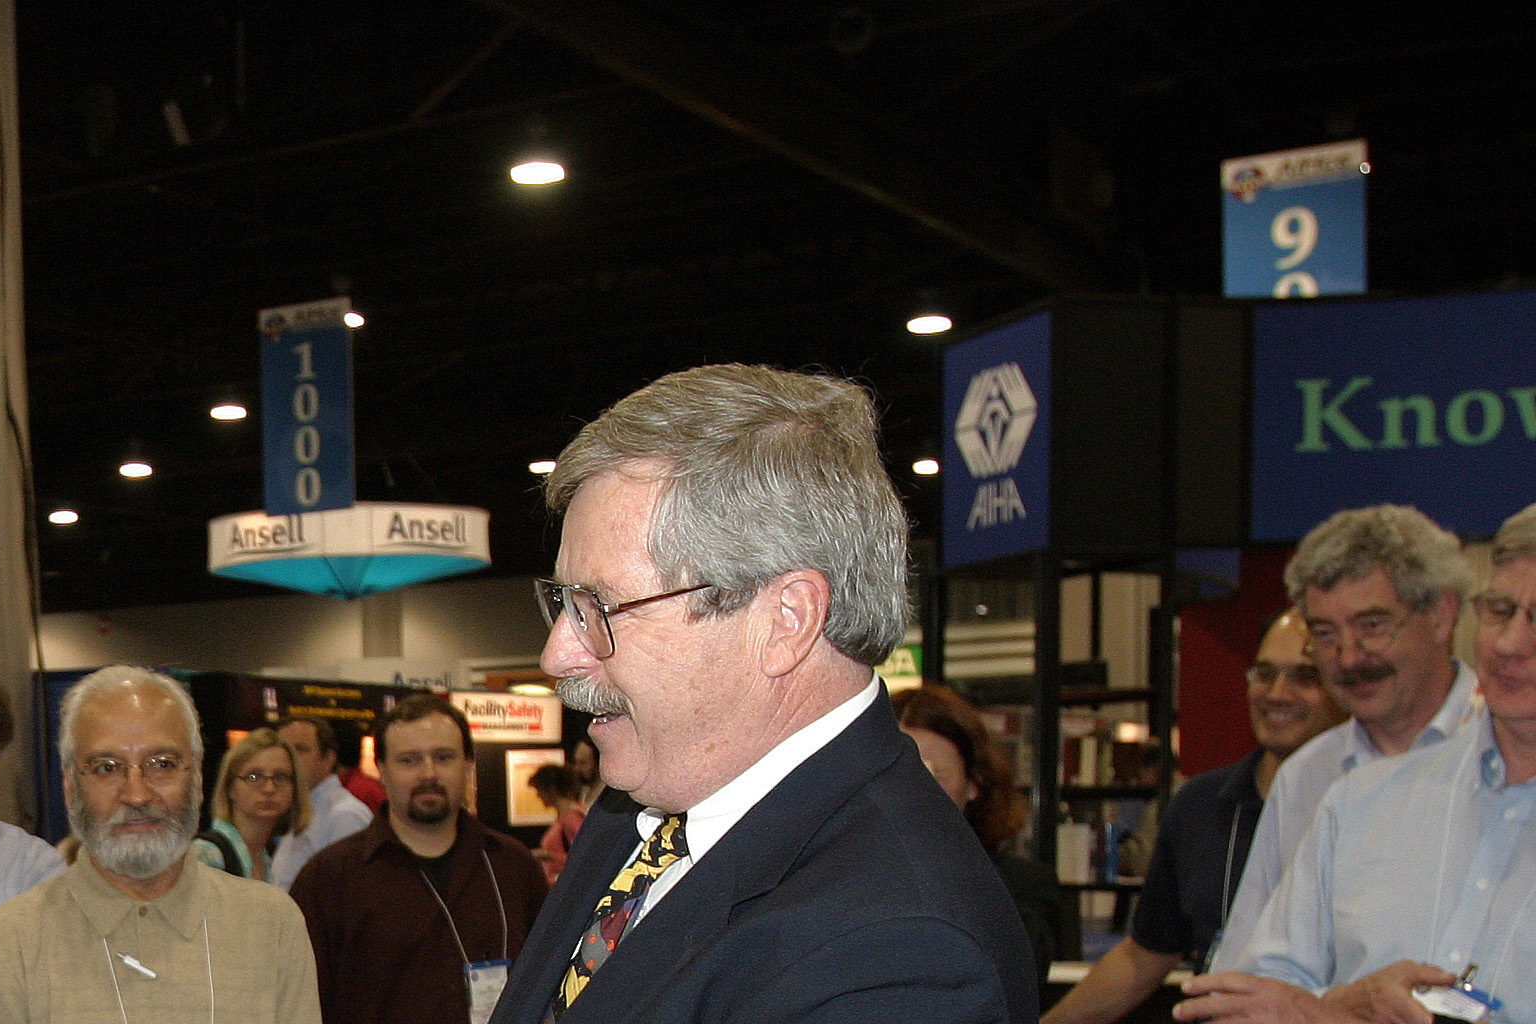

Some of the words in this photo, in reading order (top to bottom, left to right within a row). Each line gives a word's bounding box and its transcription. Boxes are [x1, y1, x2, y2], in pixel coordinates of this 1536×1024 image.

[293, 342, 322, 507] 1000
[231, 514, 306, 550] Ansell
[387, 511, 468, 543] Ansell
